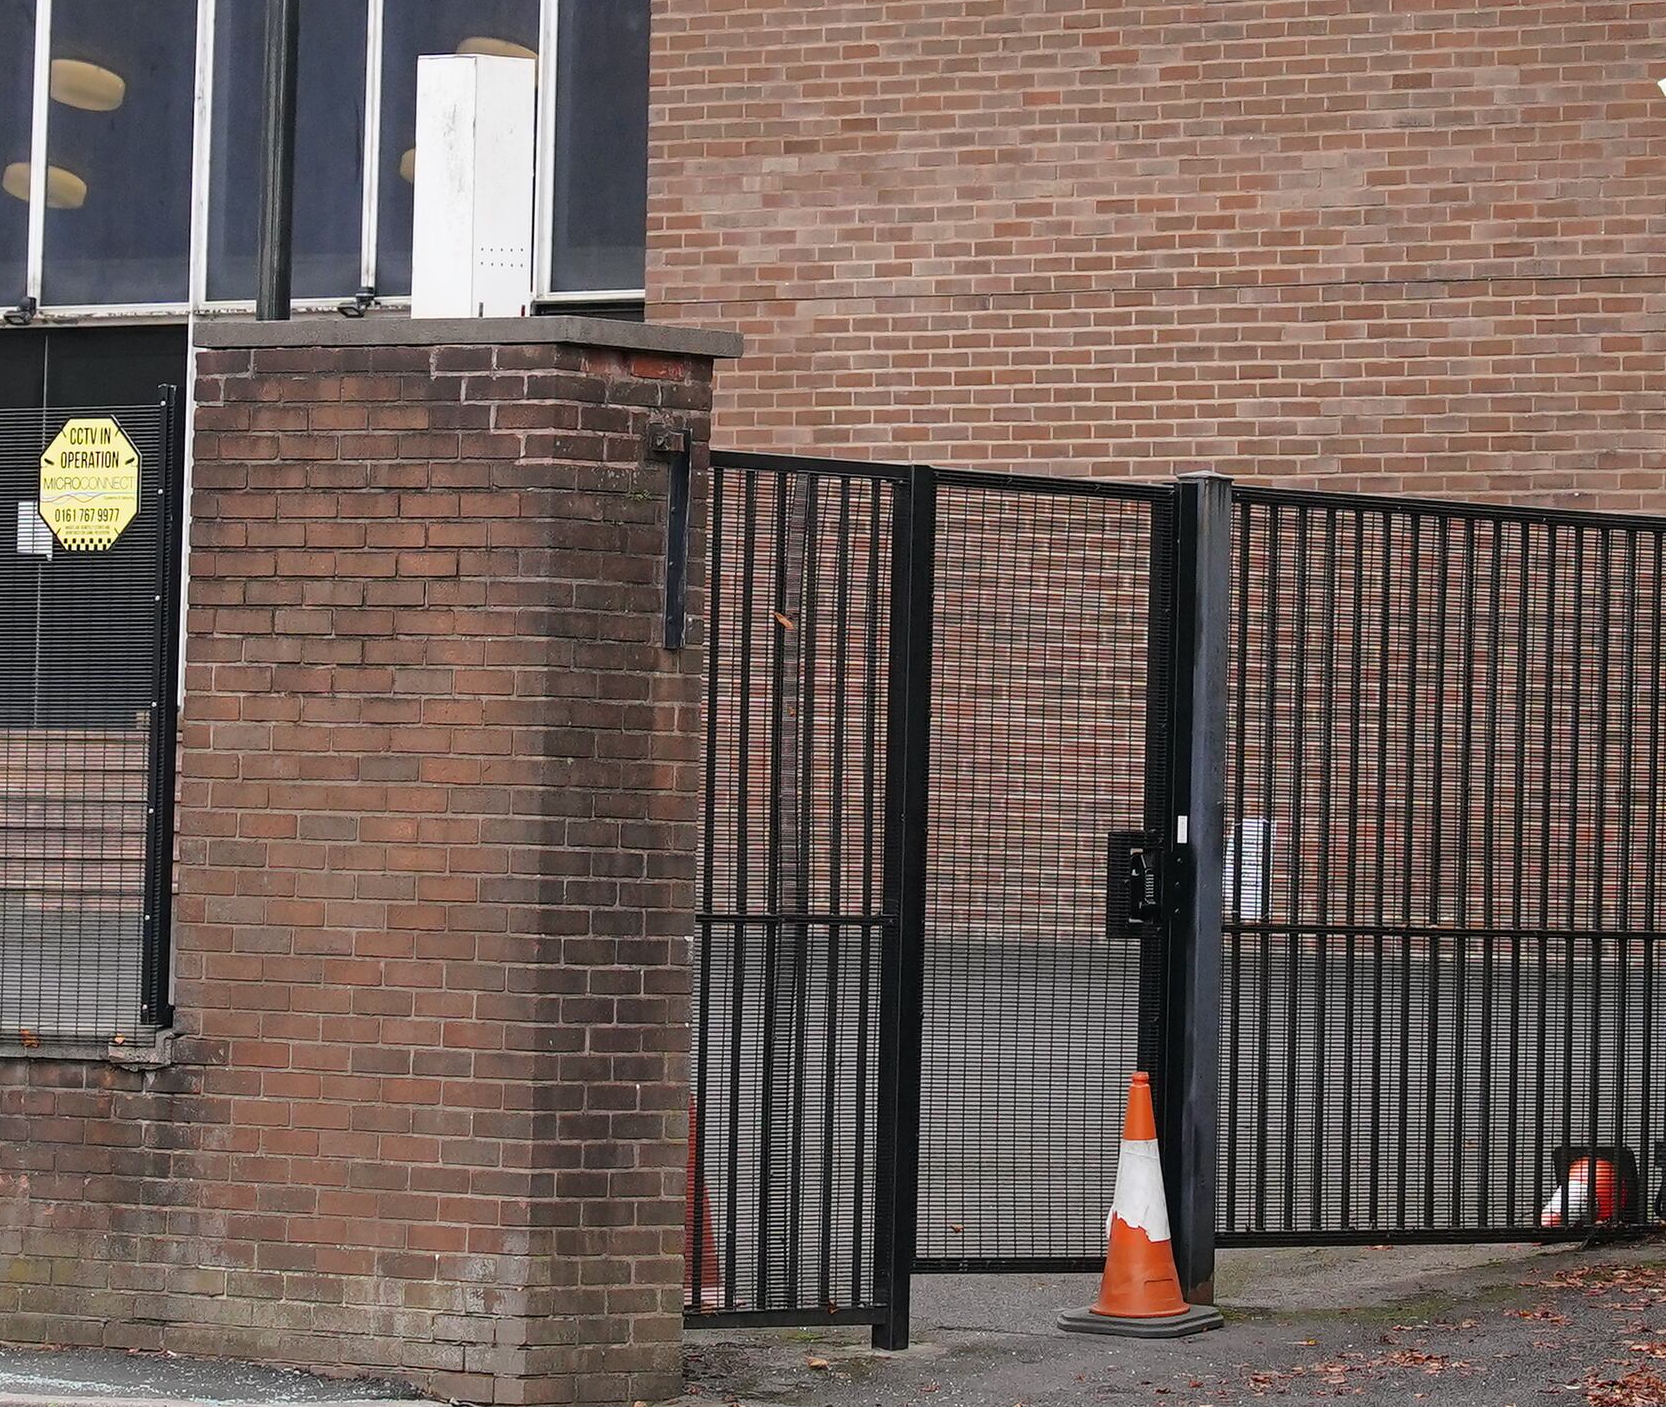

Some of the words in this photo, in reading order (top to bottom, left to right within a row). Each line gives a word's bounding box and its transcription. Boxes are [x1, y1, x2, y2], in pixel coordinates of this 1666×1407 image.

[70, 427, 98, 445] CCTV
[101, 427, 111, 445] IN
[61, 451, 119, 469] OPERATION
[44, 476, 135, 491] MICROCONNECT
[55, 508, 76, 523] 0161
[79, 508, 96, 523] 767
[97, 508, 120, 523] 9977
